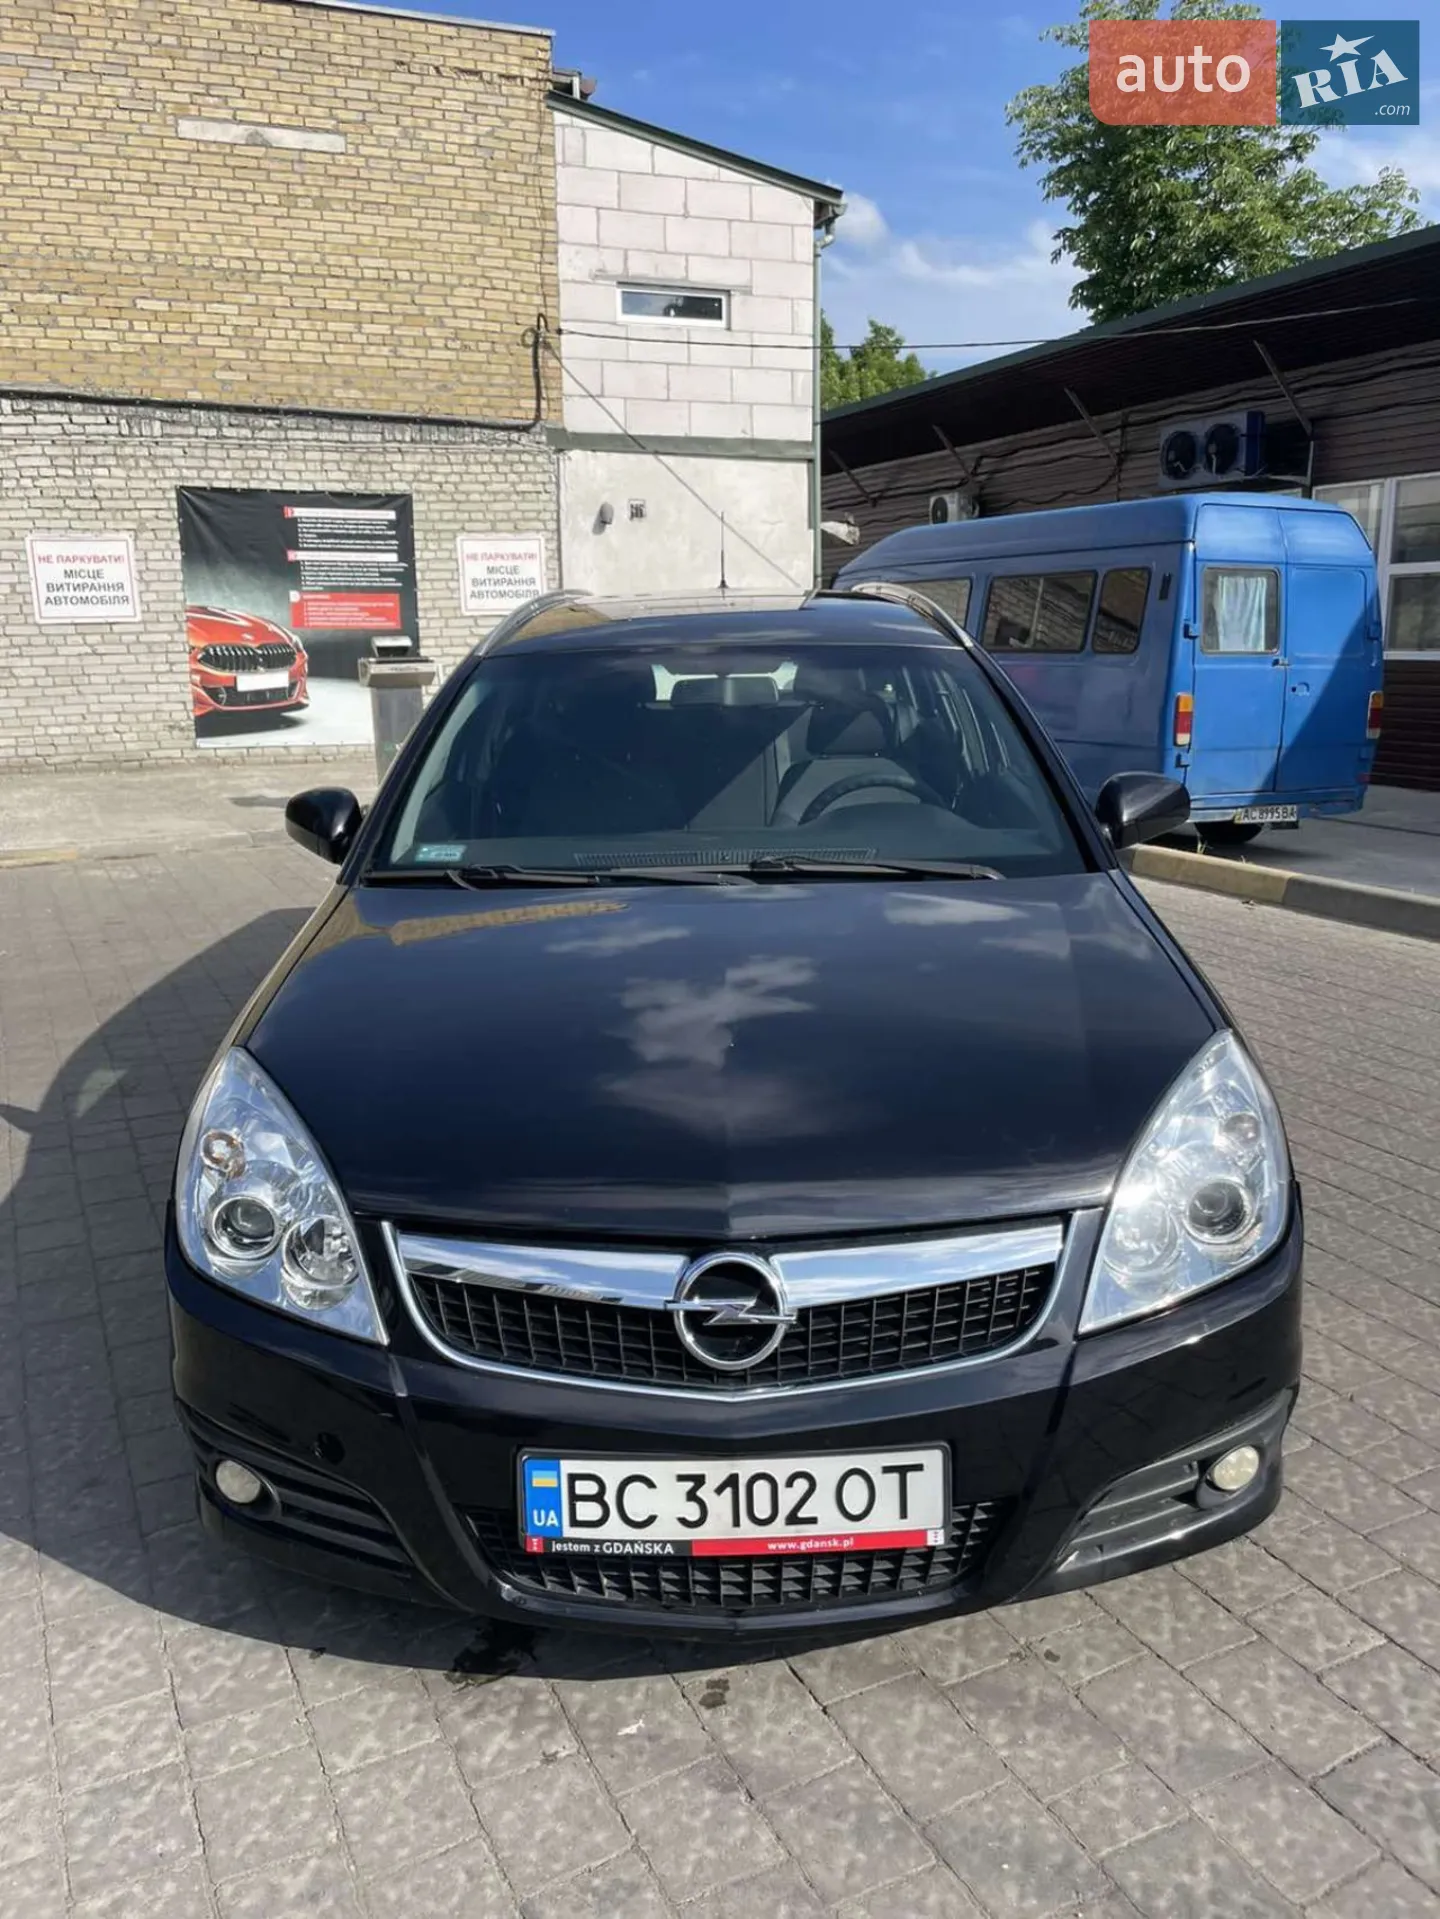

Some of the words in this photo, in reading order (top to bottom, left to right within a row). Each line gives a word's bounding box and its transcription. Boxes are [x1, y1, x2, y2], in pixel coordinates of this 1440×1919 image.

[38, 554, 54, 565] НЕ
[56, 554, 125, 565] ПАРКУВАТИ!
[466, 553, 479, 561] НЕ
[63, 568, 105, 580] МІСЦЕ
[486, 565, 520, 575] МІСЦЕ
[46, 582, 125, 593] ВИТИРАННЯ
[471, 577, 536, 587] ВИТИРАННЯ
[44, 595, 130, 606] АВТОМОБІЛЯ
[567, 1472, 658, 1529] BC
[676, 1471, 818, 1528] 3102
[835, 1463, 925, 1522] OT
[533, 1509, 559, 1528] UA
[551, 1541, 591, 1553] jestem
[593, 1544, 601, 1553] z
[602, 1540, 674, 1555] GDAŃSKA
[767, 1537, 855, 1552] www.gdansk.pl
